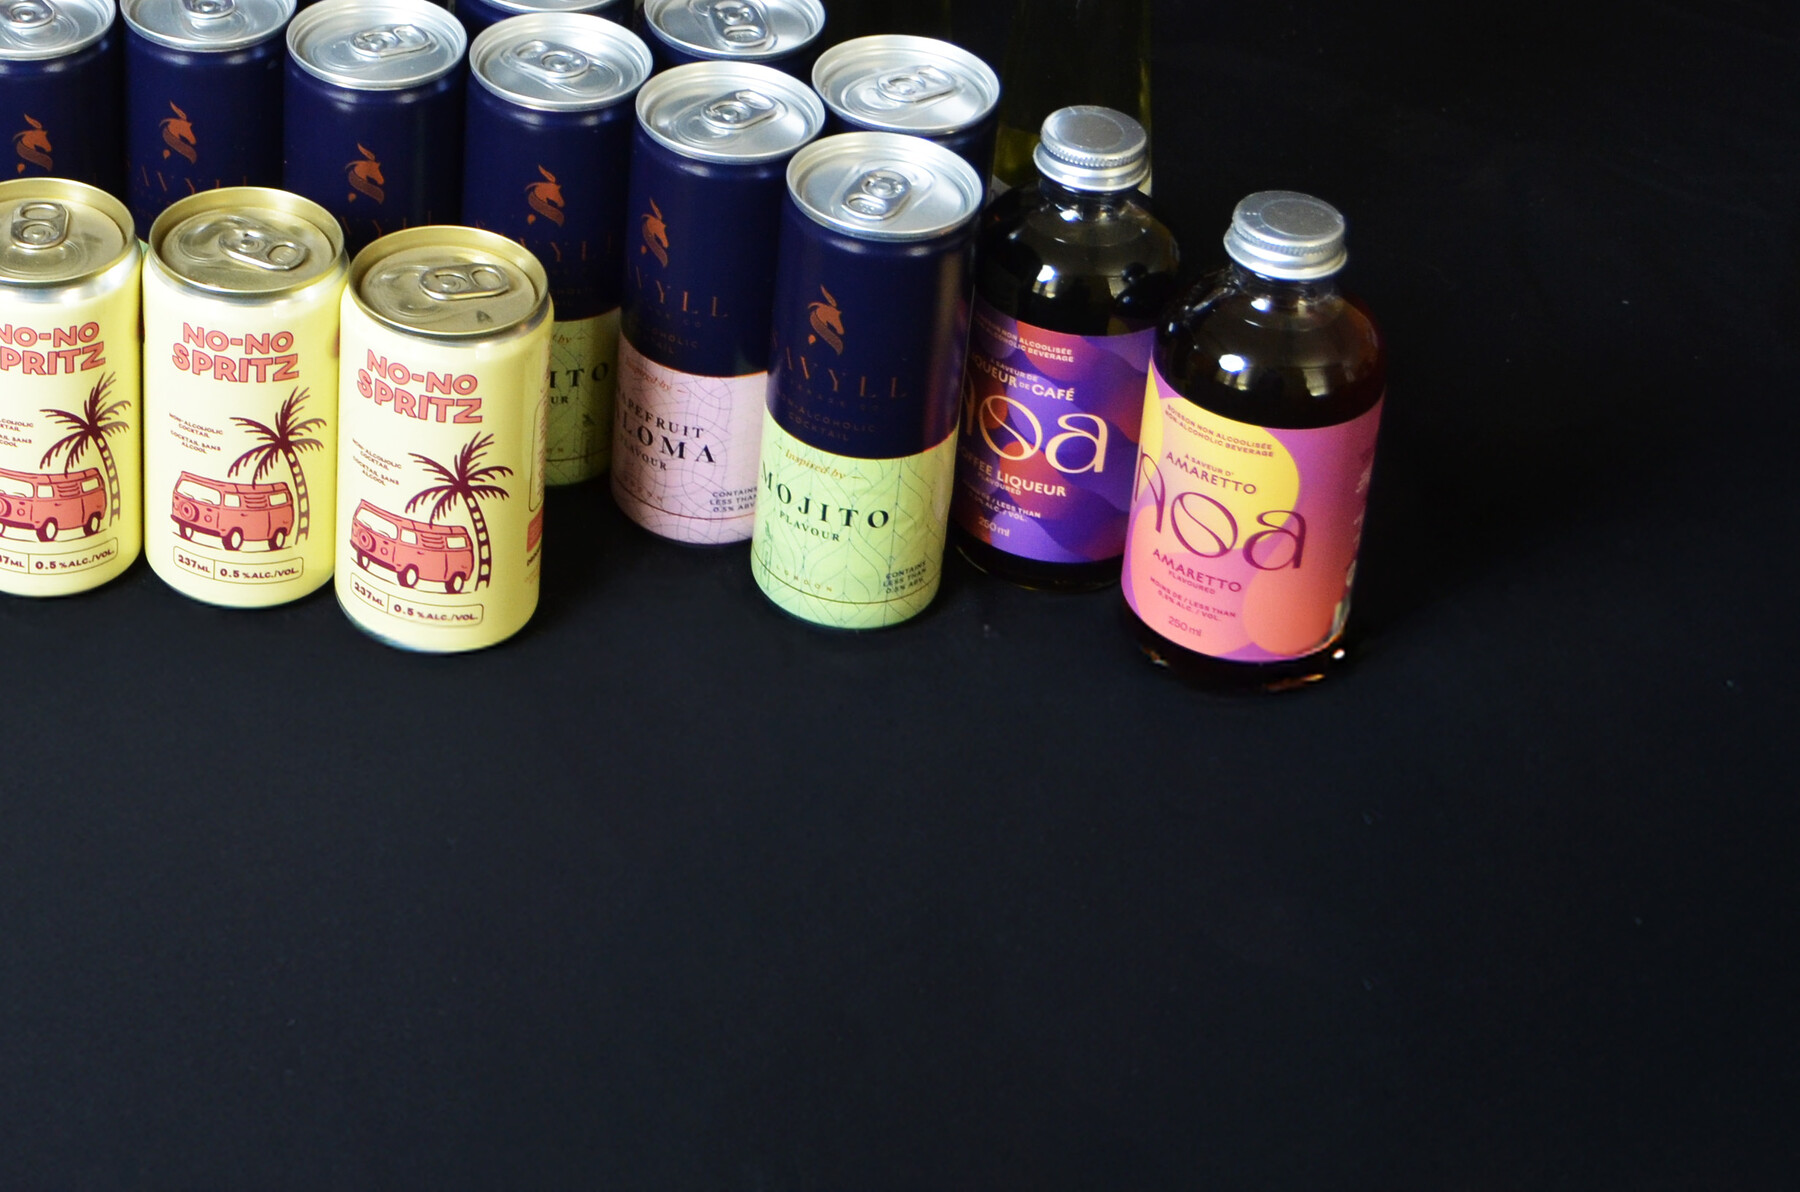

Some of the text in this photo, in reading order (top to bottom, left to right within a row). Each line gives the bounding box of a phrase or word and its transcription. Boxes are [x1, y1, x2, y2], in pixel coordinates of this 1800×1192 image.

[183, 322, 294, 354] NO-NO
[172, 342, 299, 383] SPRITZ
[1028, 348, 1074, 363] BEVERAGE
[367, 348, 478, 395] NO-NO
[357, 368, 482, 424] SPRITZ
[1031, 384, 1075, 401] CAFÉ
[1197, 423, 1214, 436] NON
[1216, 432, 1273, 450] ALCOOLISÉE
[1225, 442, 1274, 457] BEVERAGE
[785, 448, 847, 480] Inspired by
[1166, 451, 1257, 495] AMARETTO
[1190, 456, 1223, 474] SAVEUR
[761, 459, 890, 528] MOJITO
[997, 470, 1067, 497] LIQUEUR
[779, 510, 840, 542] FLAVOUR
[178, 554, 210, 573] 237ML
[1152, 548, 1242, 592] AMARETTO
[354, 582, 385, 607] 237ML
[1168, 570, 1216, 595] FLAVOURED
[1212, 607, 1236, 617] THAN
